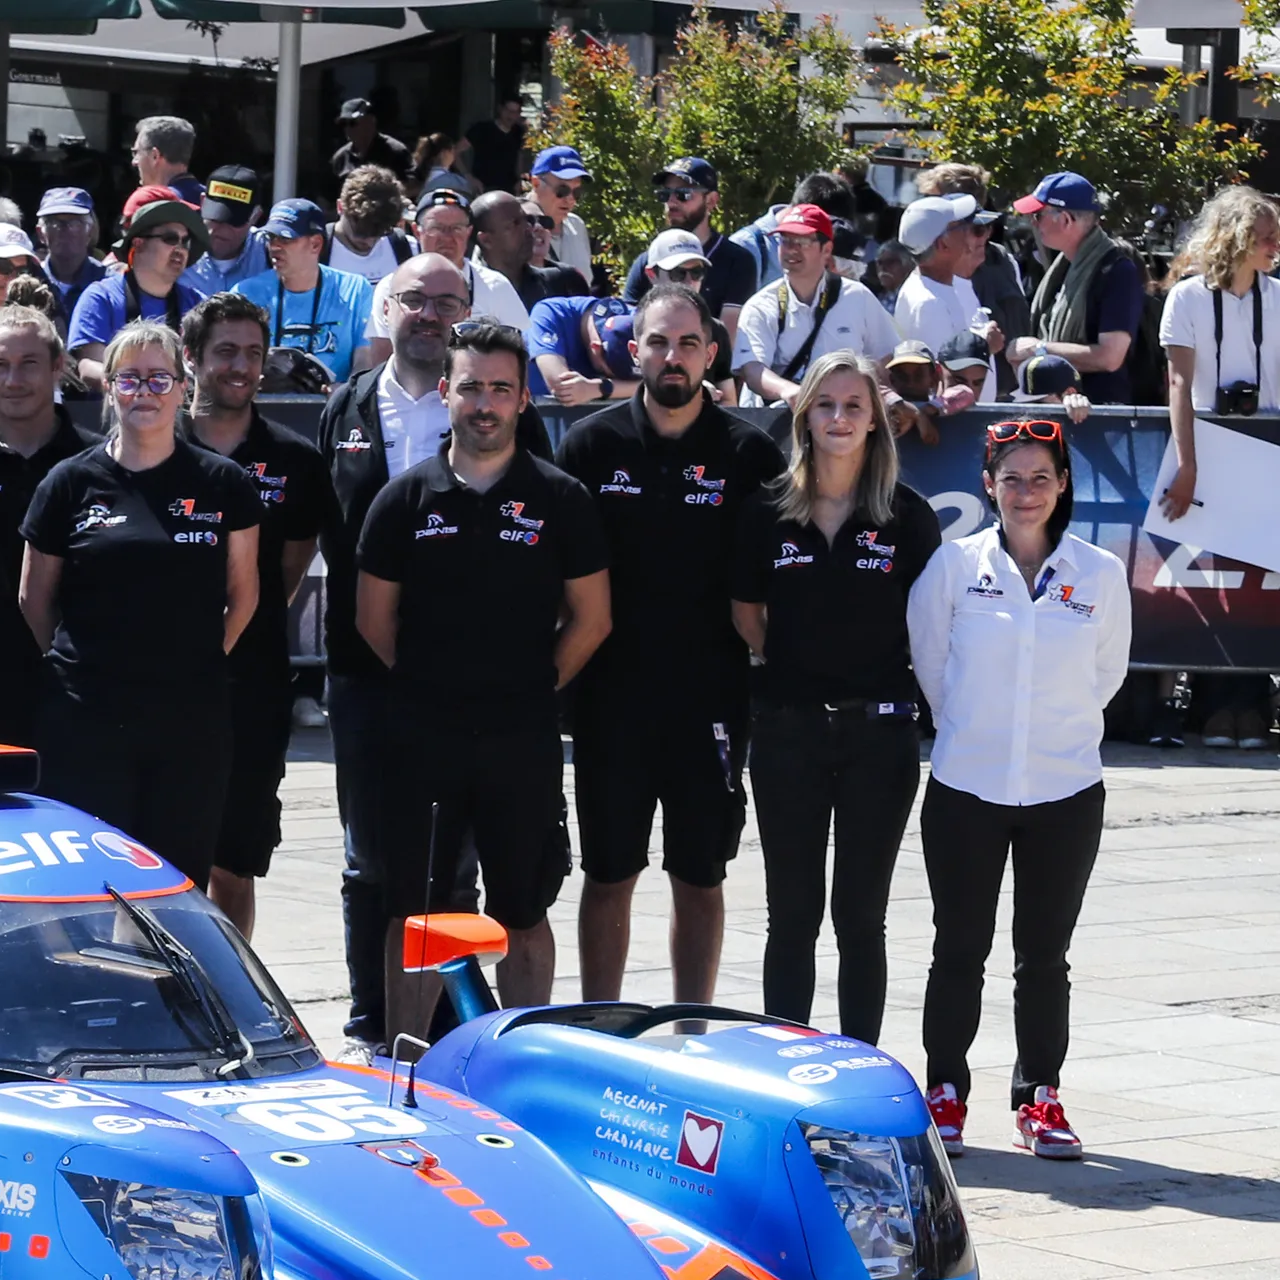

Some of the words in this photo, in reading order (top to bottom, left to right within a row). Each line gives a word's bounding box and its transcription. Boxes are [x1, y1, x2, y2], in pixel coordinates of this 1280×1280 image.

[260, 489, 273, 500] lf
[684, 492, 709, 505] elf
[174, 532, 203, 544] elf
[500, 528, 525, 542] elf
[856, 557, 881, 570] elf
[603, 1086, 668, 1116] MECENAT
[236, 1095, 428, 1141] 65
[592, 1148, 640, 1172] enfants
[647, 1166, 662, 1179] du
[669, 1175, 714, 1197] monde
